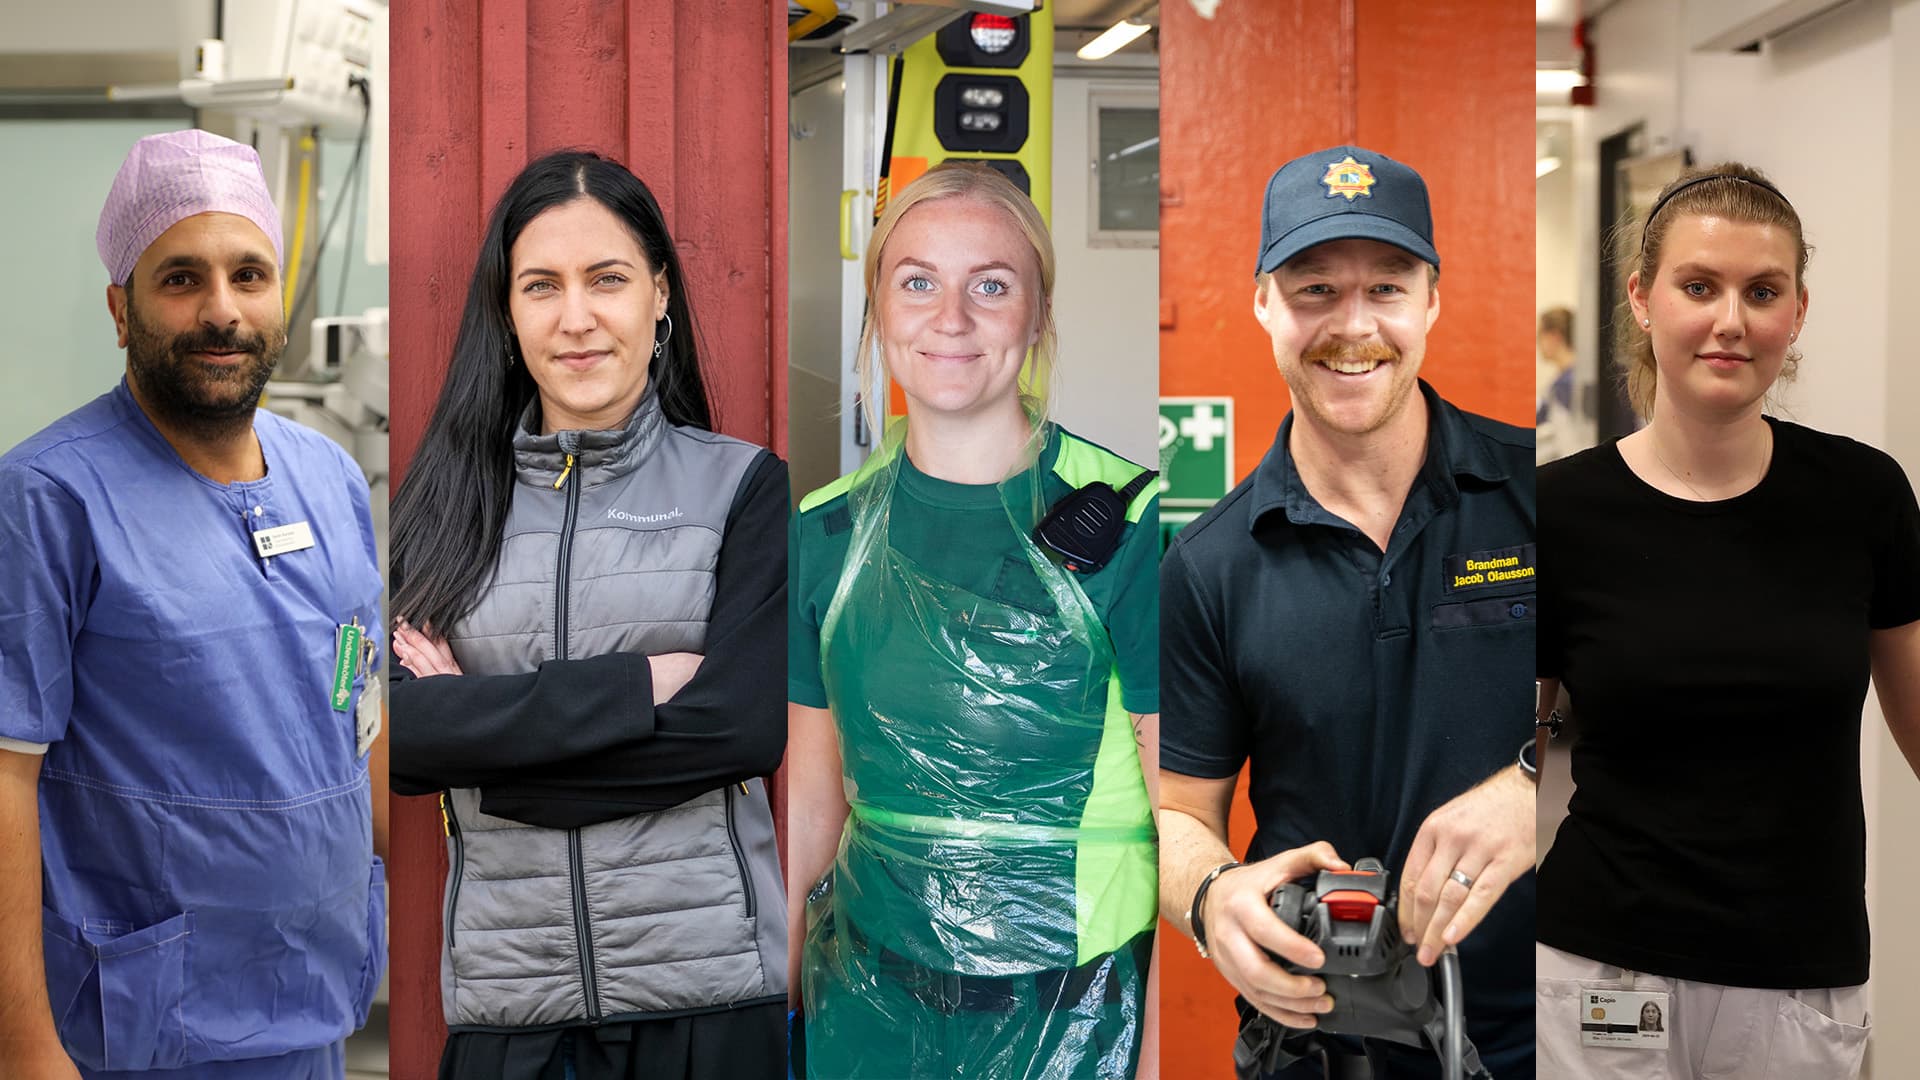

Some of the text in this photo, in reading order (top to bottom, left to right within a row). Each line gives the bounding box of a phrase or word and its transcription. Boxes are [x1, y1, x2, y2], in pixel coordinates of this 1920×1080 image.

[1466, 556, 1519, 571] Brandman
[1453, 567, 1535, 587] Jacob Olausson
